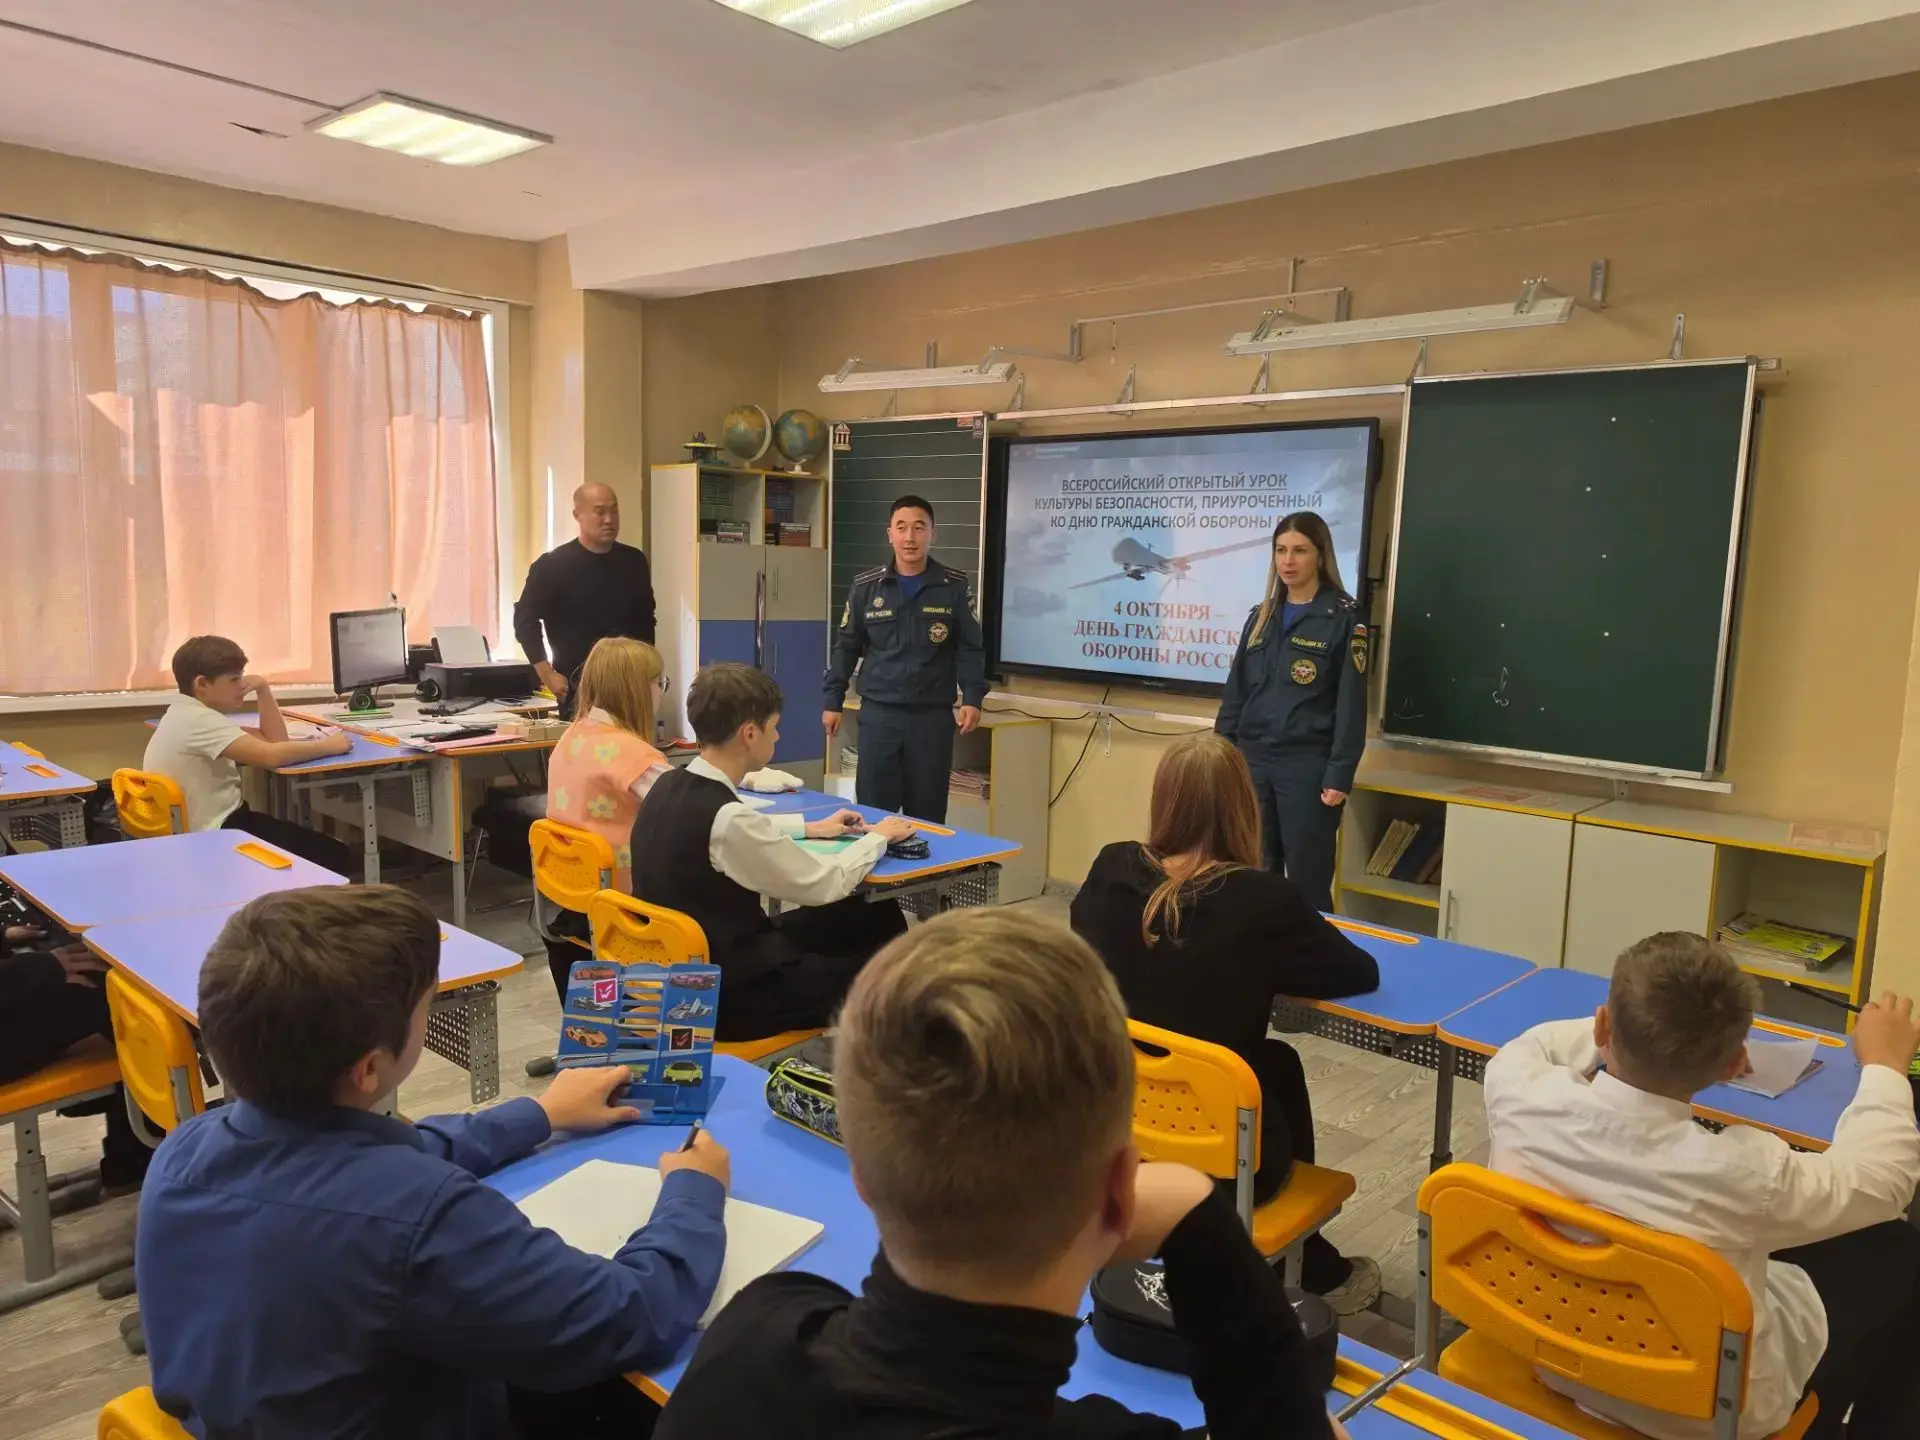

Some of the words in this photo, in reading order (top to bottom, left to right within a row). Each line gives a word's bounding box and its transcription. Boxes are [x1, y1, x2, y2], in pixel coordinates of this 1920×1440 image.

[1062, 474, 1165, 492] ВСЕРОССИЙСКИЙ
[1168, 472, 1245, 489] ОТКРЫТЫЙ
[1250, 473, 1288, 488] УРОК
[1034, 497, 1092, 510] КУЛЬТУРЫ
[1095, 496, 1197, 511] БЕЗОПАСНОСТИ,
[1201, 490, 1322, 509] ПРИУРОЧЕННЫЙ
[1051, 515, 1066, 528] КО
[1068, 515, 1098, 530] ДНЮ
[1101, 512, 1196, 531] ГРАЖДАНСКОЙ
[1200, 514, 1272, 528] ОБОРОНЫ
[1114, 601, 1122, 615] 4
[1126, 601, 1211, 620] ОКТЯБРЯ
[1074, 620, 1120, 637] ДЕНЬ
[1124, 623, 1240, 646] ГРАЖДАНСК
[1082, 642, 1170, 664] ОБОРОНЫ
[1176, 650, 1234, 669] РОСС
